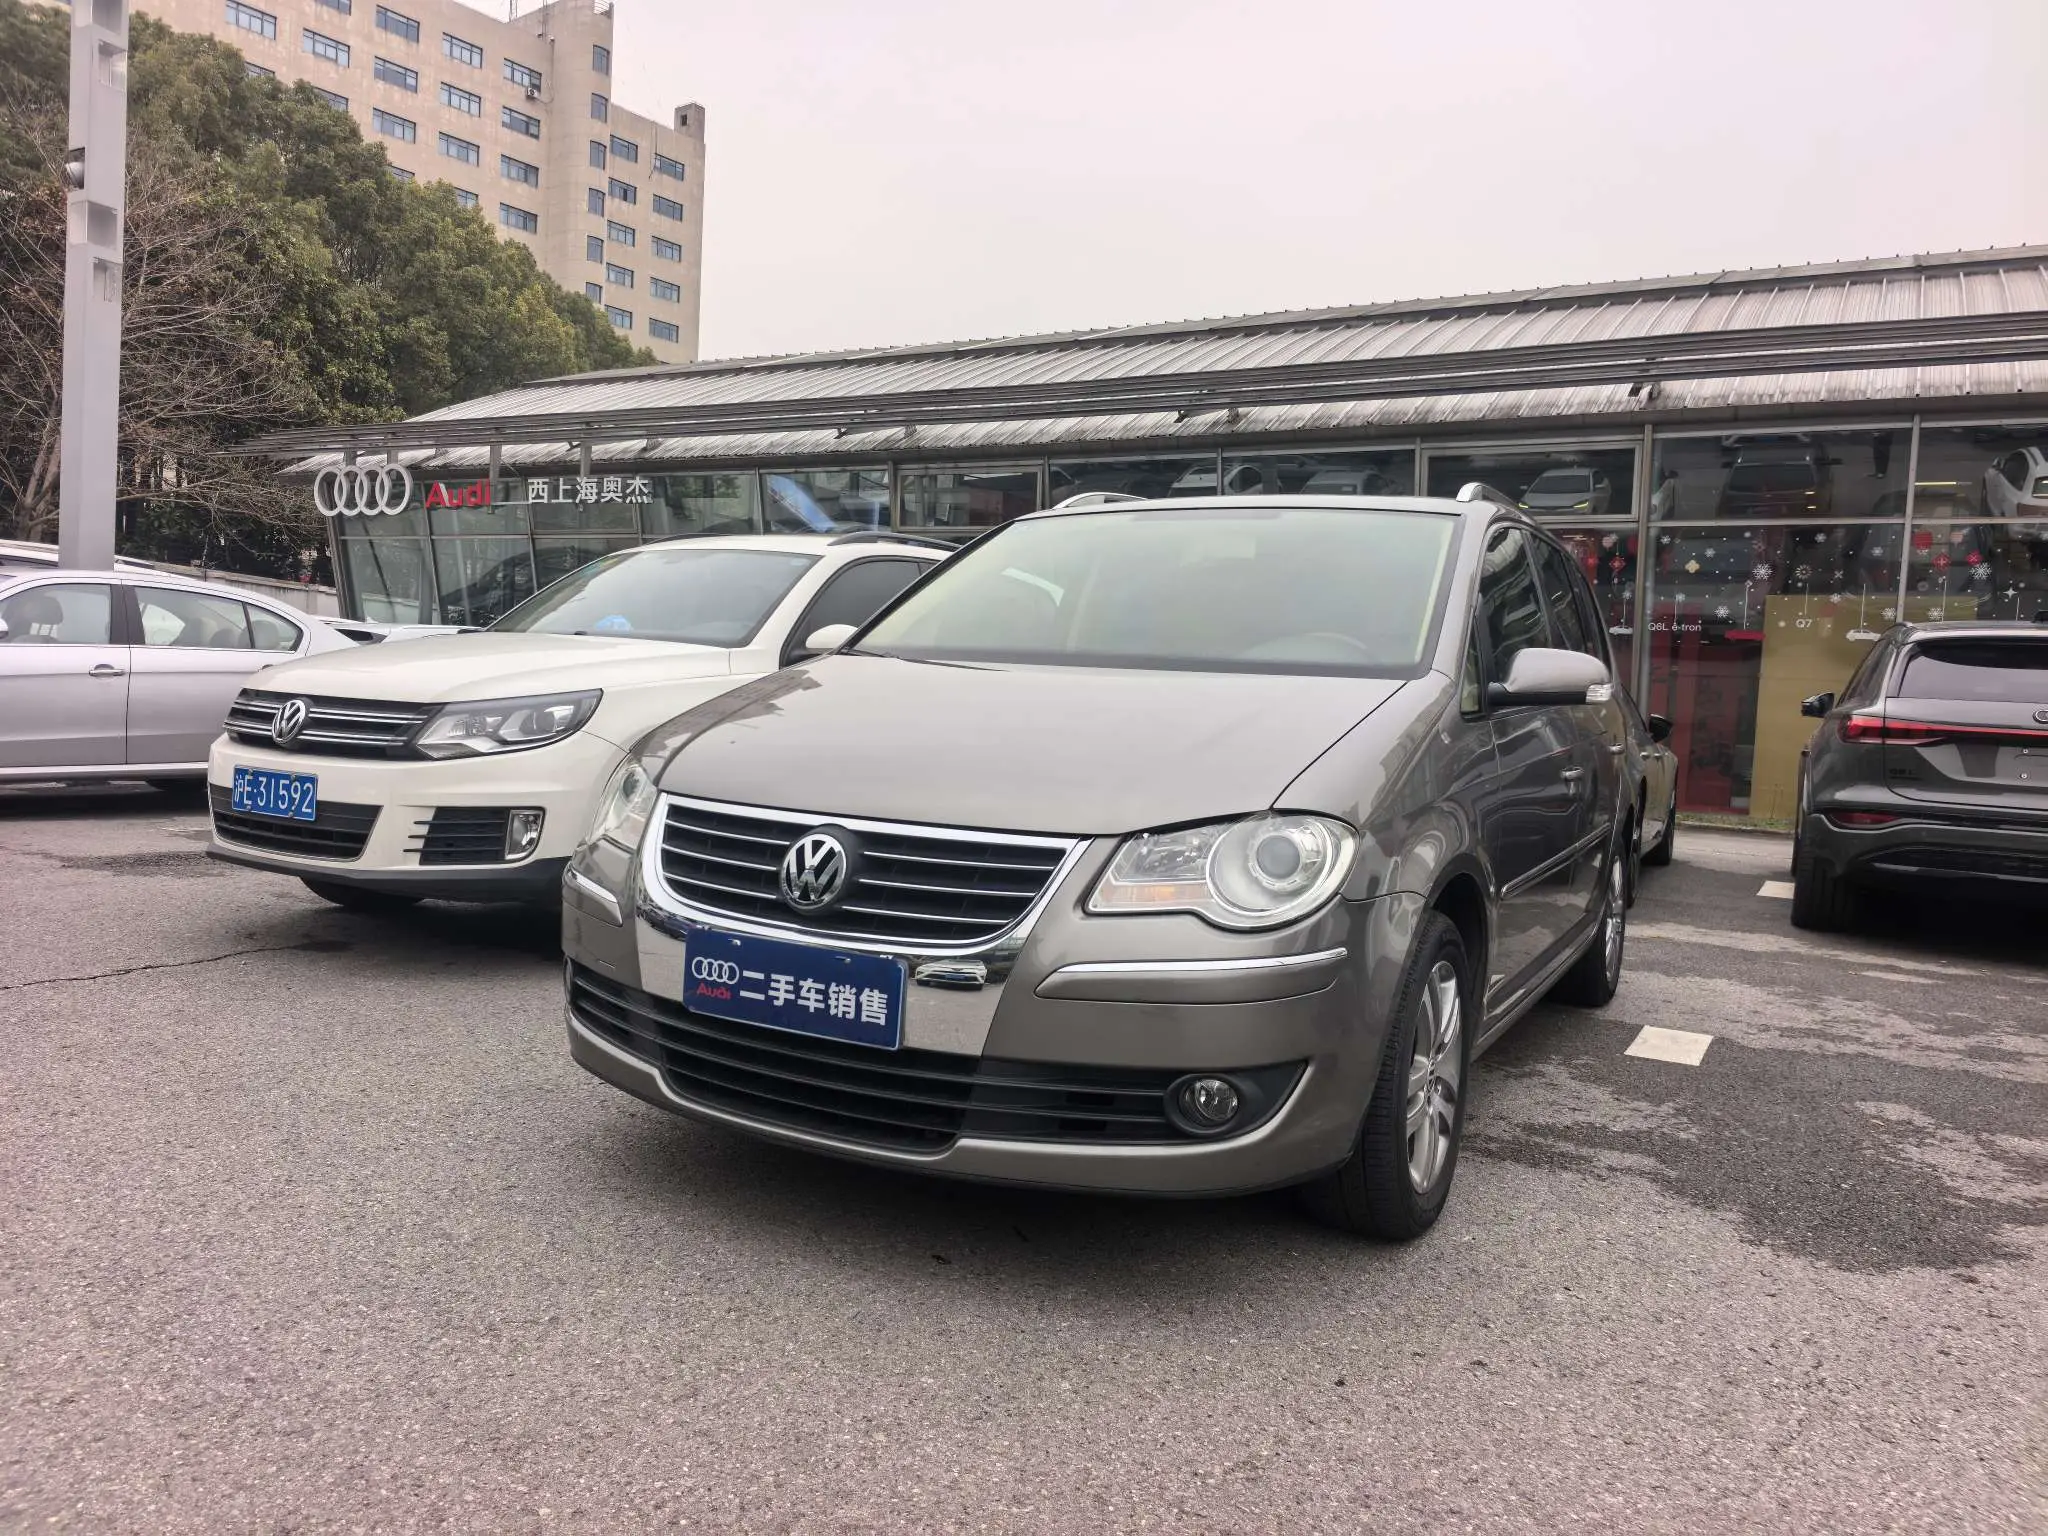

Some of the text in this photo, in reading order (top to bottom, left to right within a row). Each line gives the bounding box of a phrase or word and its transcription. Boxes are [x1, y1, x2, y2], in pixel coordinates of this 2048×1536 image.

[425, 478, 491, 508] Audi
[527, 476, 651, 505] 西上海奥杰
[1648, 621, 1668, 631] Q6L
[1796, 618, 1813, 629] Q7
[696, 982, 732, 1001] Audi
[739, 970, 889, 1026] 二手车销售
